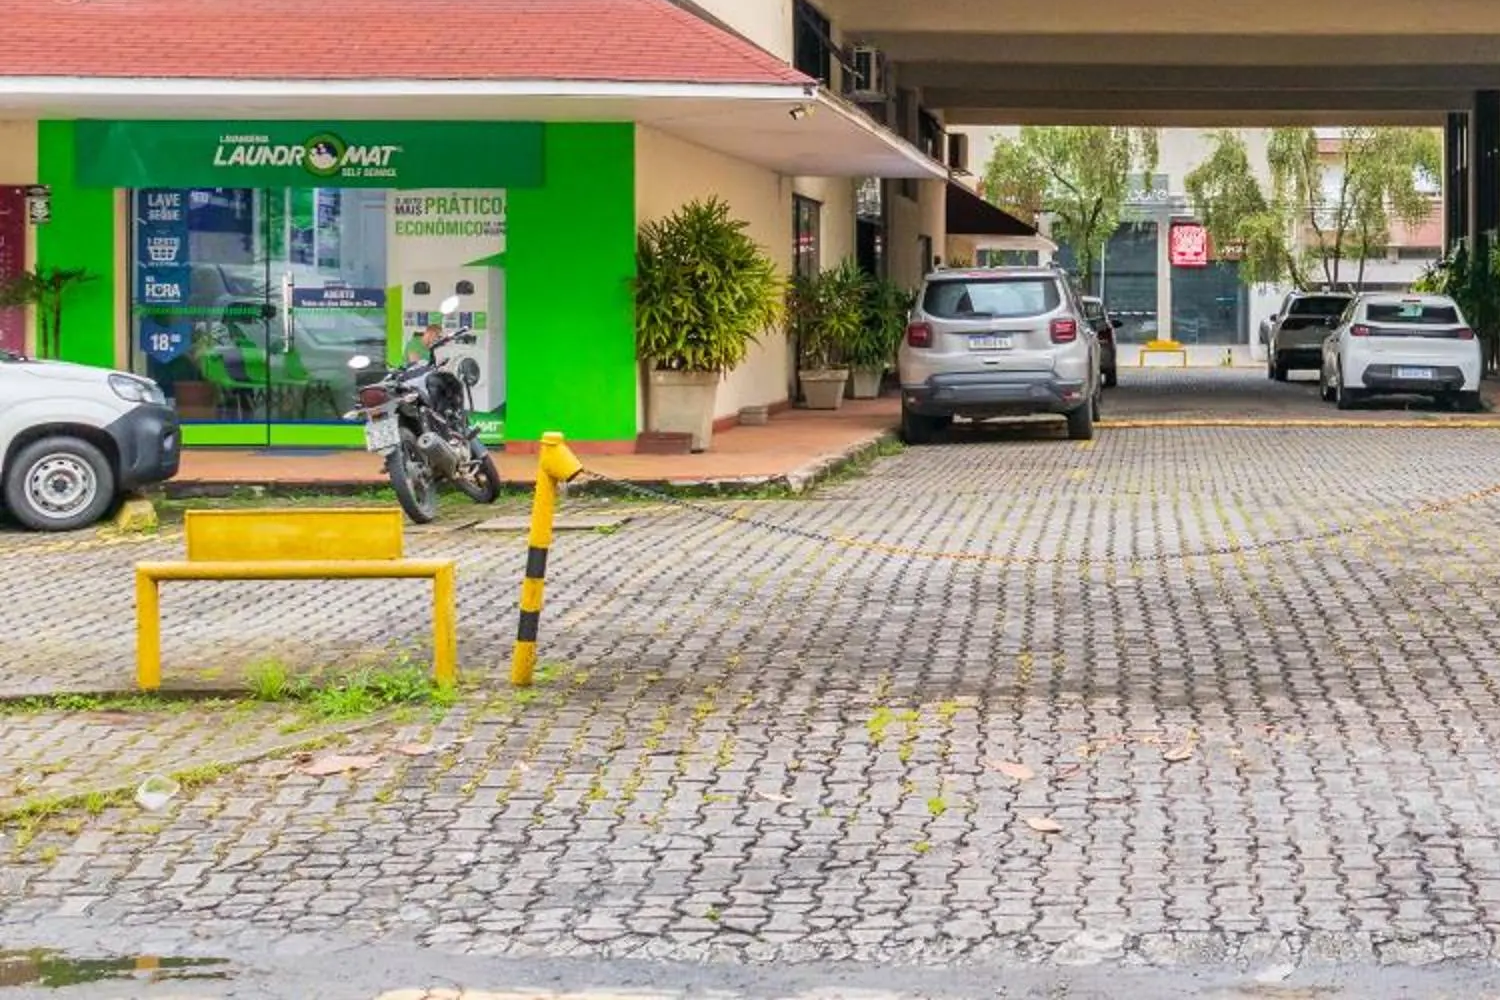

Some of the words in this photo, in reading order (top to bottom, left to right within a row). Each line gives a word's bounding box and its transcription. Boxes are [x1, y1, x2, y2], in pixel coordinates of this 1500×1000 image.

[147, 193, 181, 207] LAVE
[425, 192, 502, 215] PRÁTICO
[396, 218, 483, 236] ECONÔMICO
